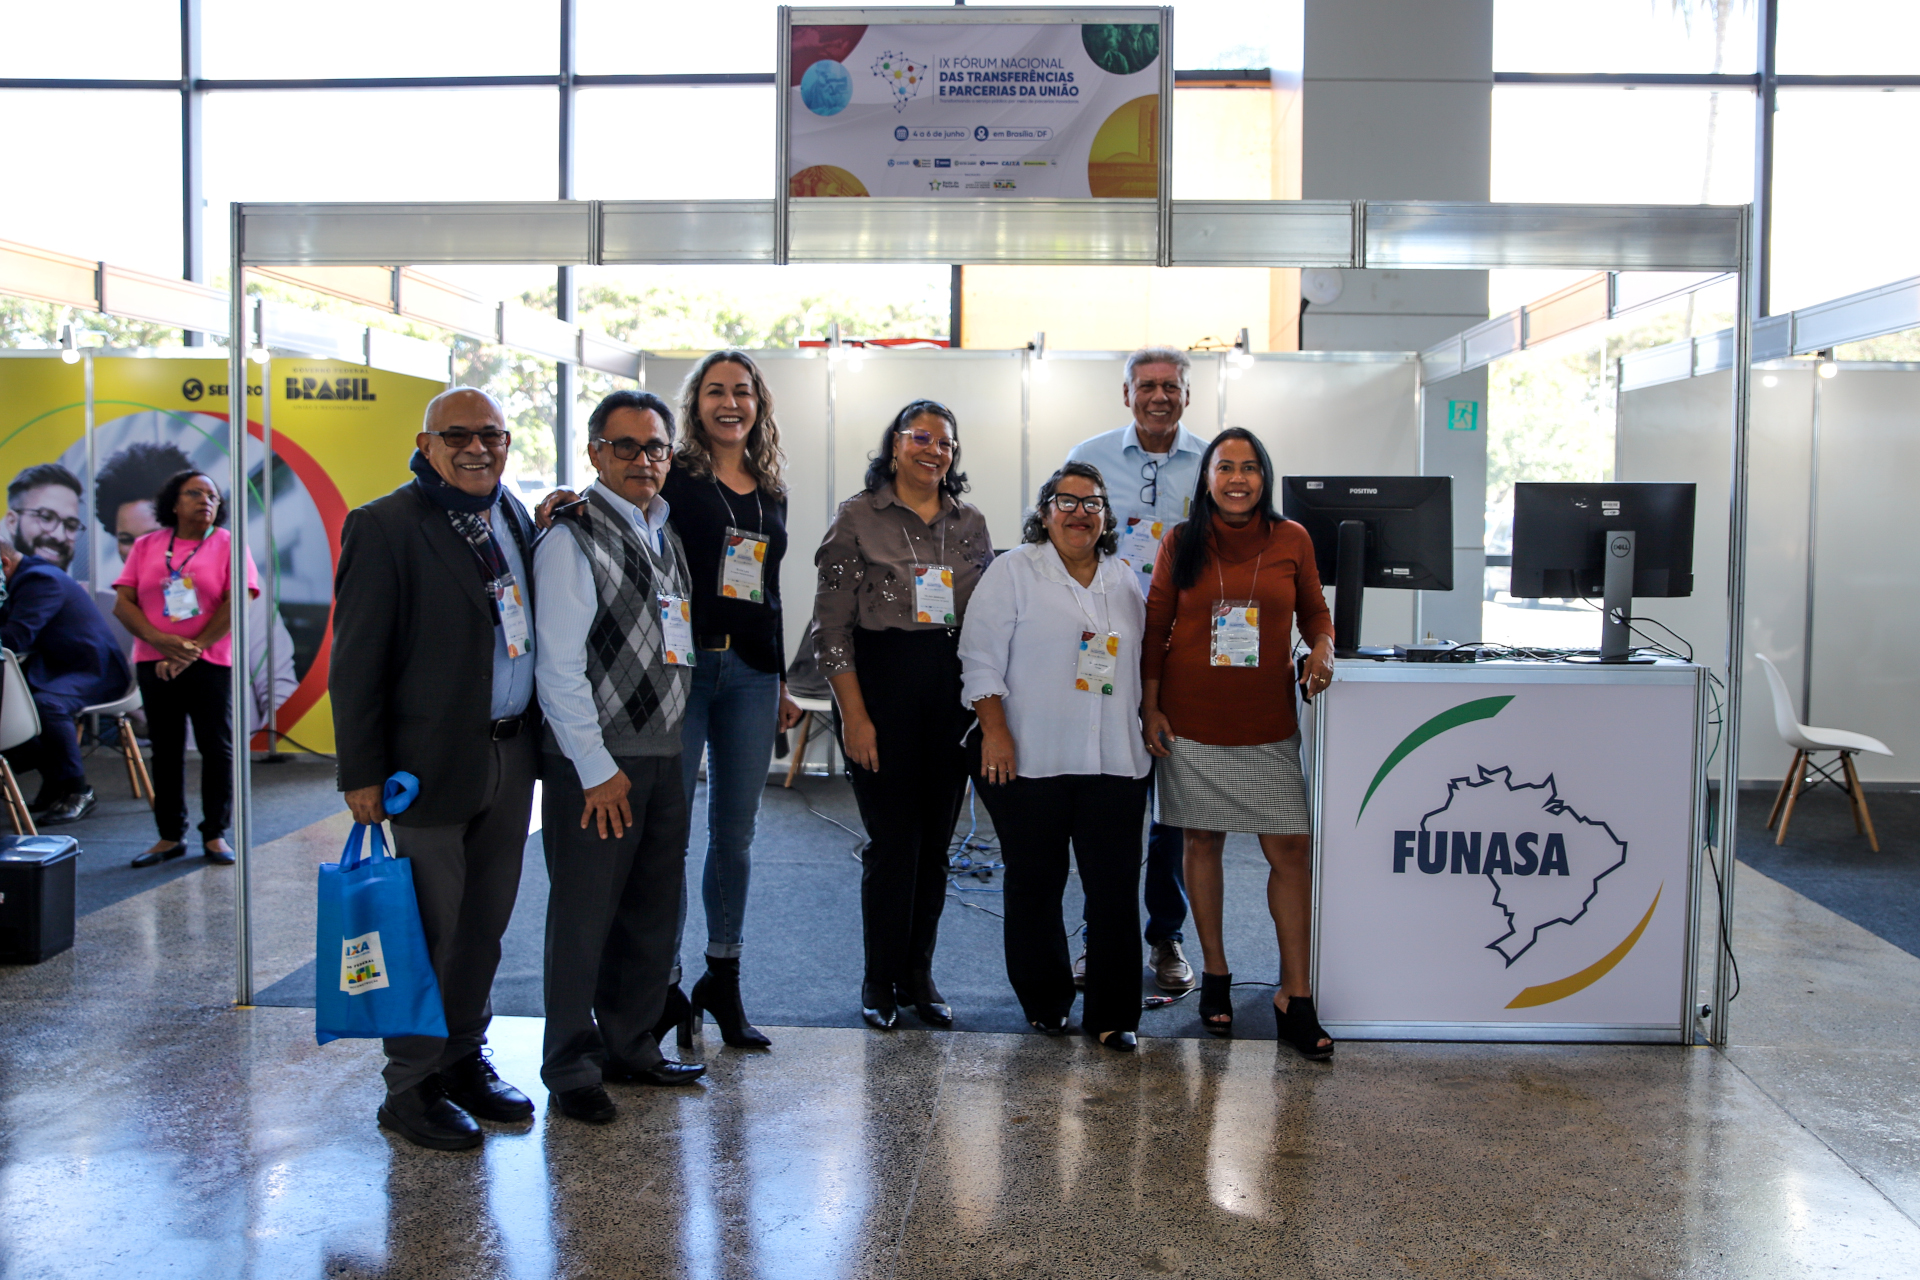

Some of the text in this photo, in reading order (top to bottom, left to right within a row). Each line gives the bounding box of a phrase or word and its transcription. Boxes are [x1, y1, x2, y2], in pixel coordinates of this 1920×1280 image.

[939, 55, 1064, 69] IX FÓRUM NACIONAL
[939, 69, 1074, 82] DAS TRANSFERÊNCIAS
[939, 83, 1079, 97] E PARCERIAS DA UNIÃO
[932, 130, 943, 138] de
[943, 130, 965, 140] junho
[208, 384, 263, 396] SERO
[286, 377, 376, 401] BRASIL
[1393, 830, 1570, 876] FUNASA
[345, 941, 370, 956] IXA
